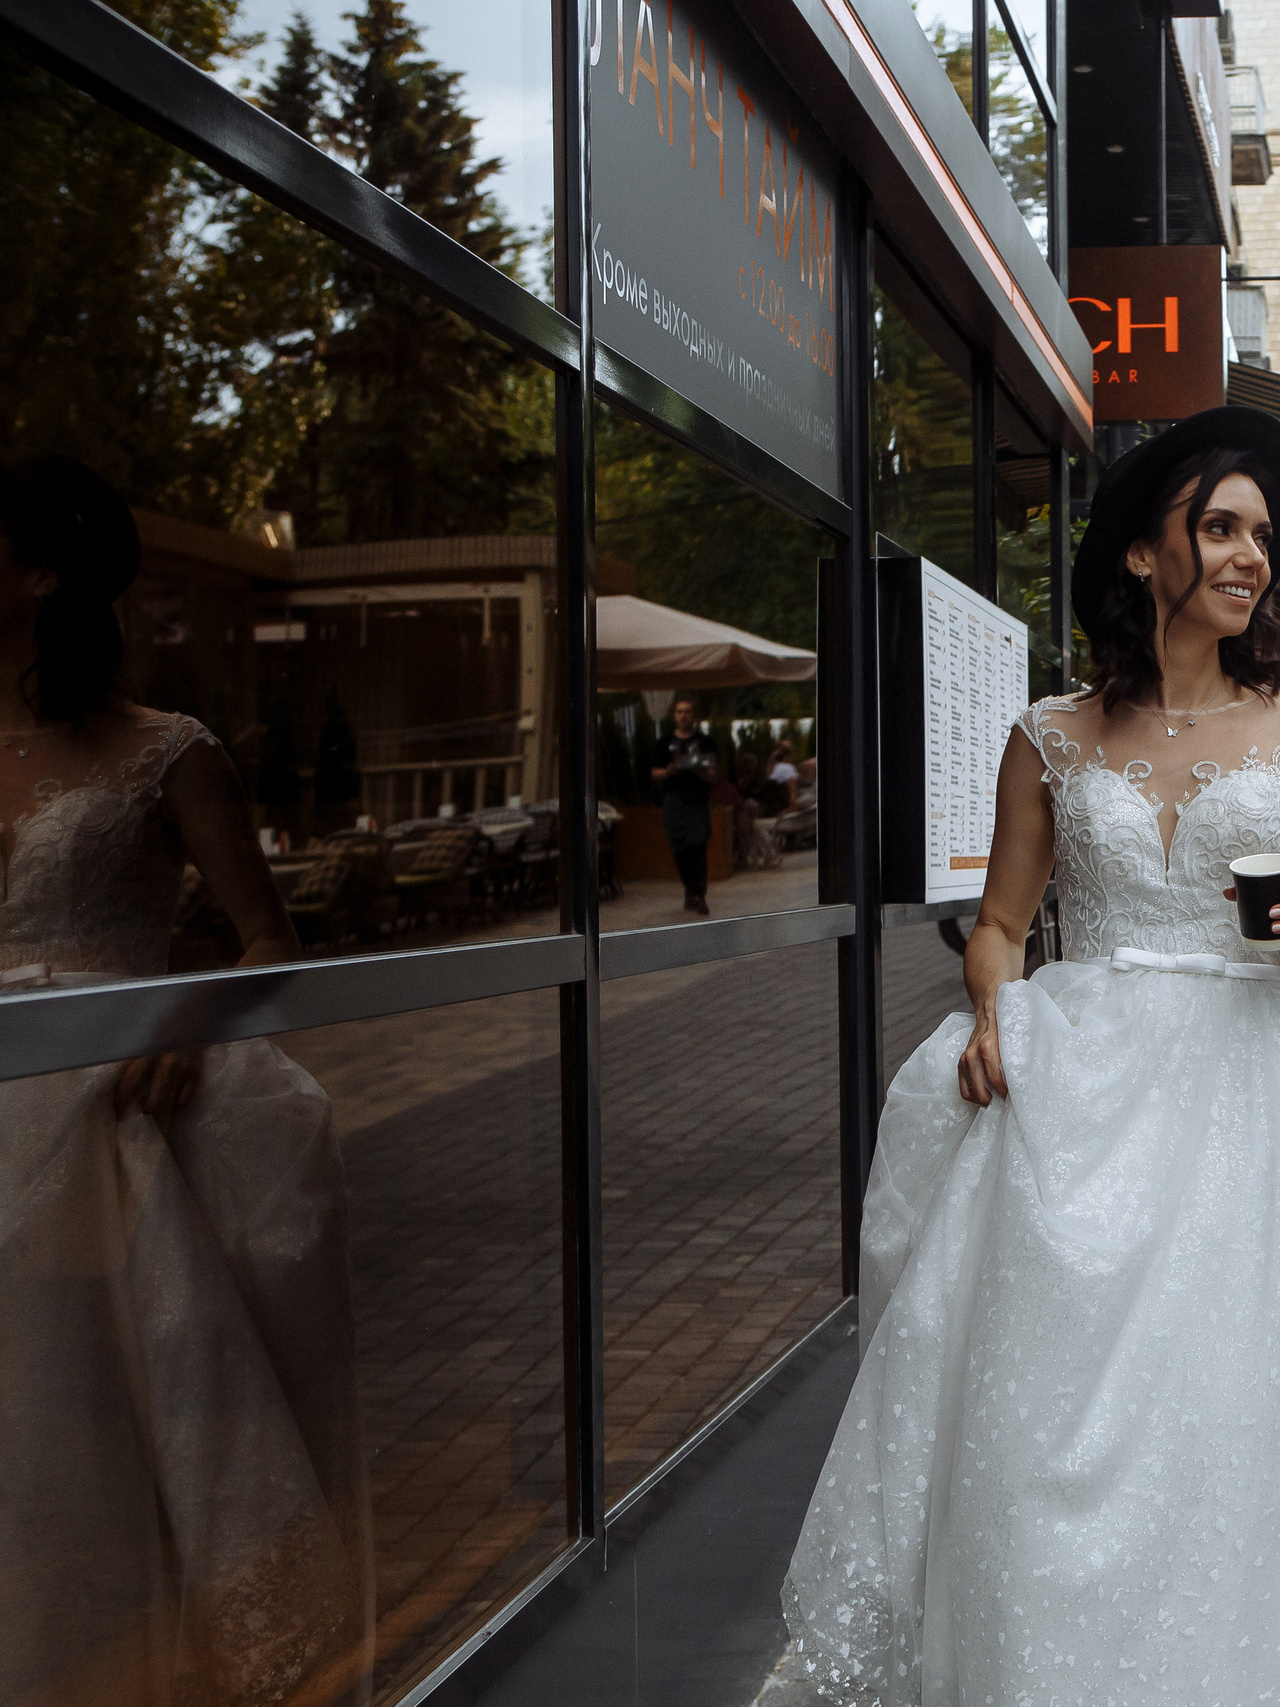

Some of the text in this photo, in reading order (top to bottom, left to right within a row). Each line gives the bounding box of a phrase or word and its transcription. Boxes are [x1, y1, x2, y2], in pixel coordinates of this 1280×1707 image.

[736, 84, 834, 312] ТАЙМ
[591, 218, 649, 315] Кроме
[653, 288, 725, 373] выходных
[727, 346, 736, 381] и
[750, 259, 786, 333] 12.00
[788, 313, 802, 351] до
[805, 312, 835, 378] 16.00
[1092, 369, 1139, 384] BAR
